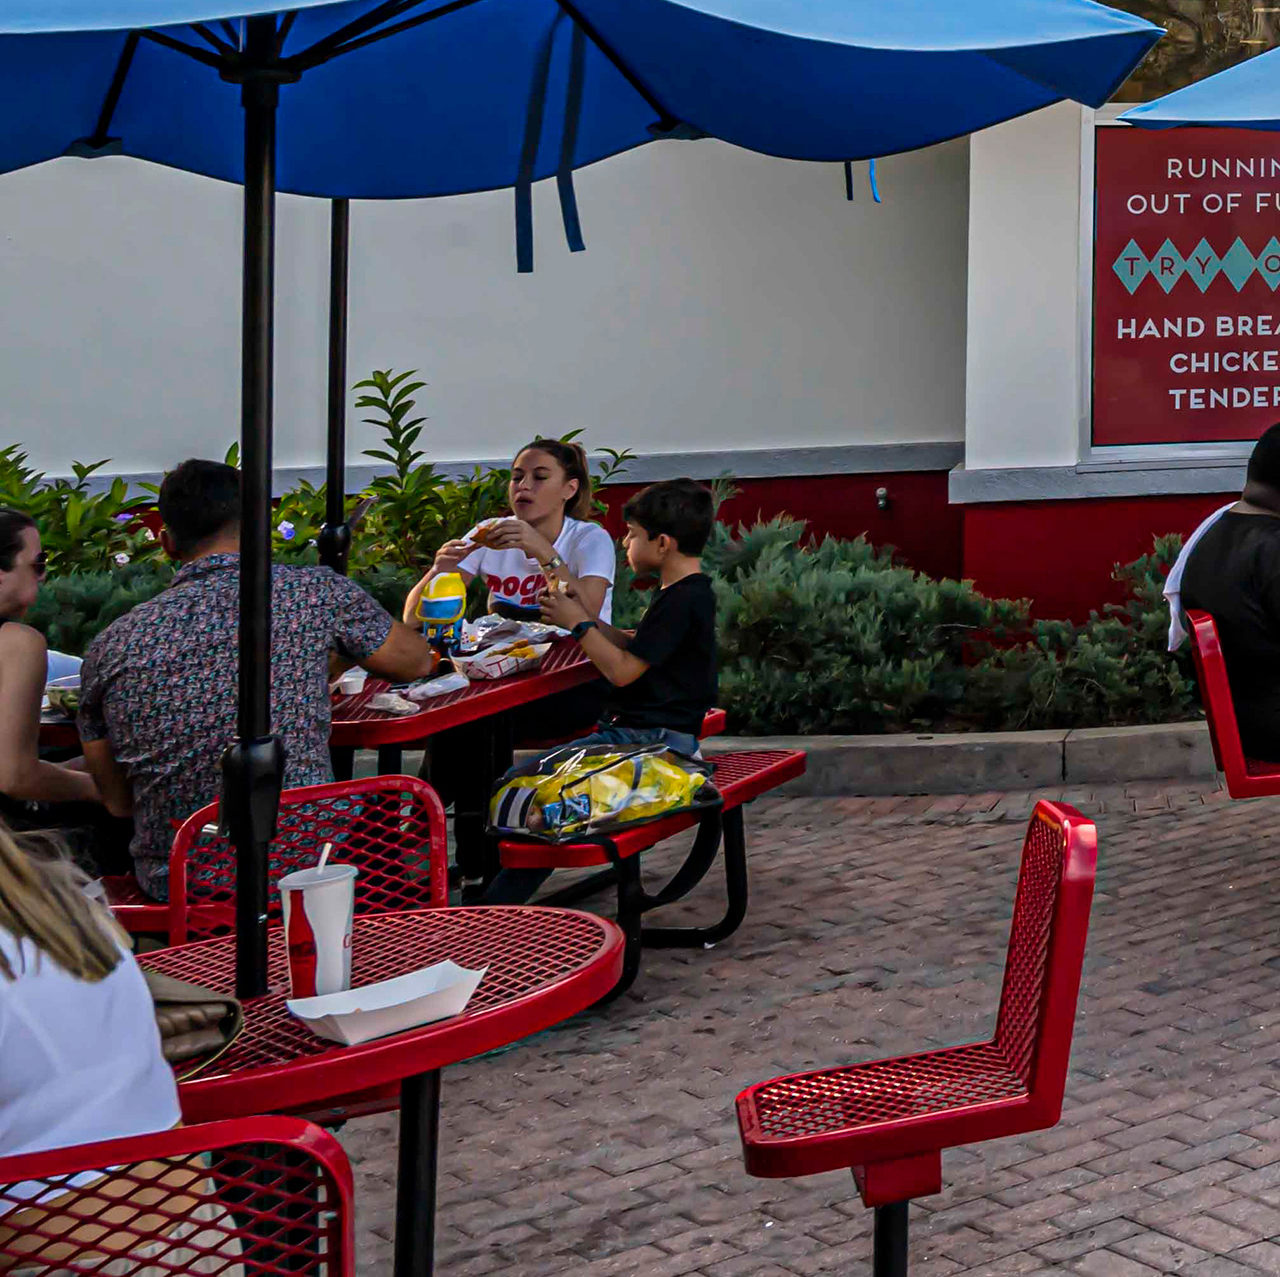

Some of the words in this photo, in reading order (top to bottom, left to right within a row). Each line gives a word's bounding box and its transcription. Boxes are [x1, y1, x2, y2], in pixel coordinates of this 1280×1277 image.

[1126, 194, 1191, 214] OUT
[1203, 193, 1242, 213] OF
[1124, 255, 1212, 276] TRY
[1117, 316, 1205, 339] HAND
